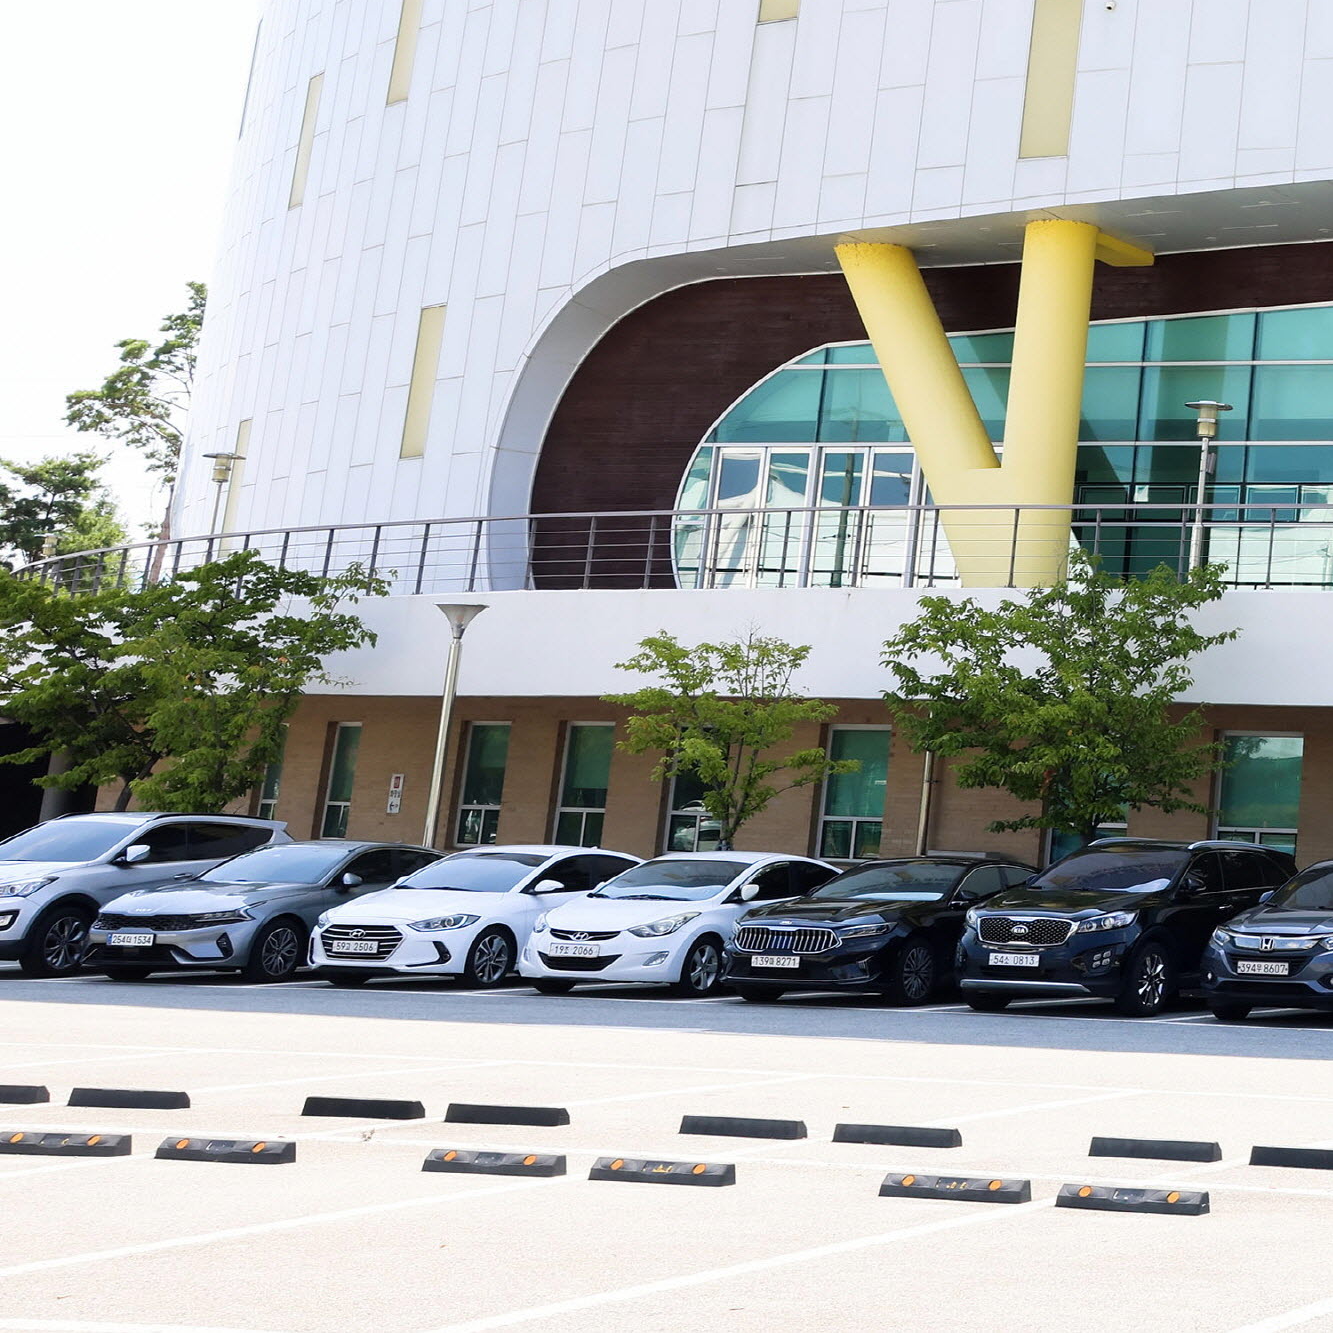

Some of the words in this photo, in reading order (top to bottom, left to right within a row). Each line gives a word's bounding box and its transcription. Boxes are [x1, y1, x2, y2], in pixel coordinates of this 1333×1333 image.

[134, 935, 152, 945] 1534
[353, 942, 374, 952] 2506
[572, 946, 594, 956] 2066
[776, 957, 796, 966] 8271
[1013, 956, 1035, 965] 0813
[1263, 964, 1286, 974] 8607
